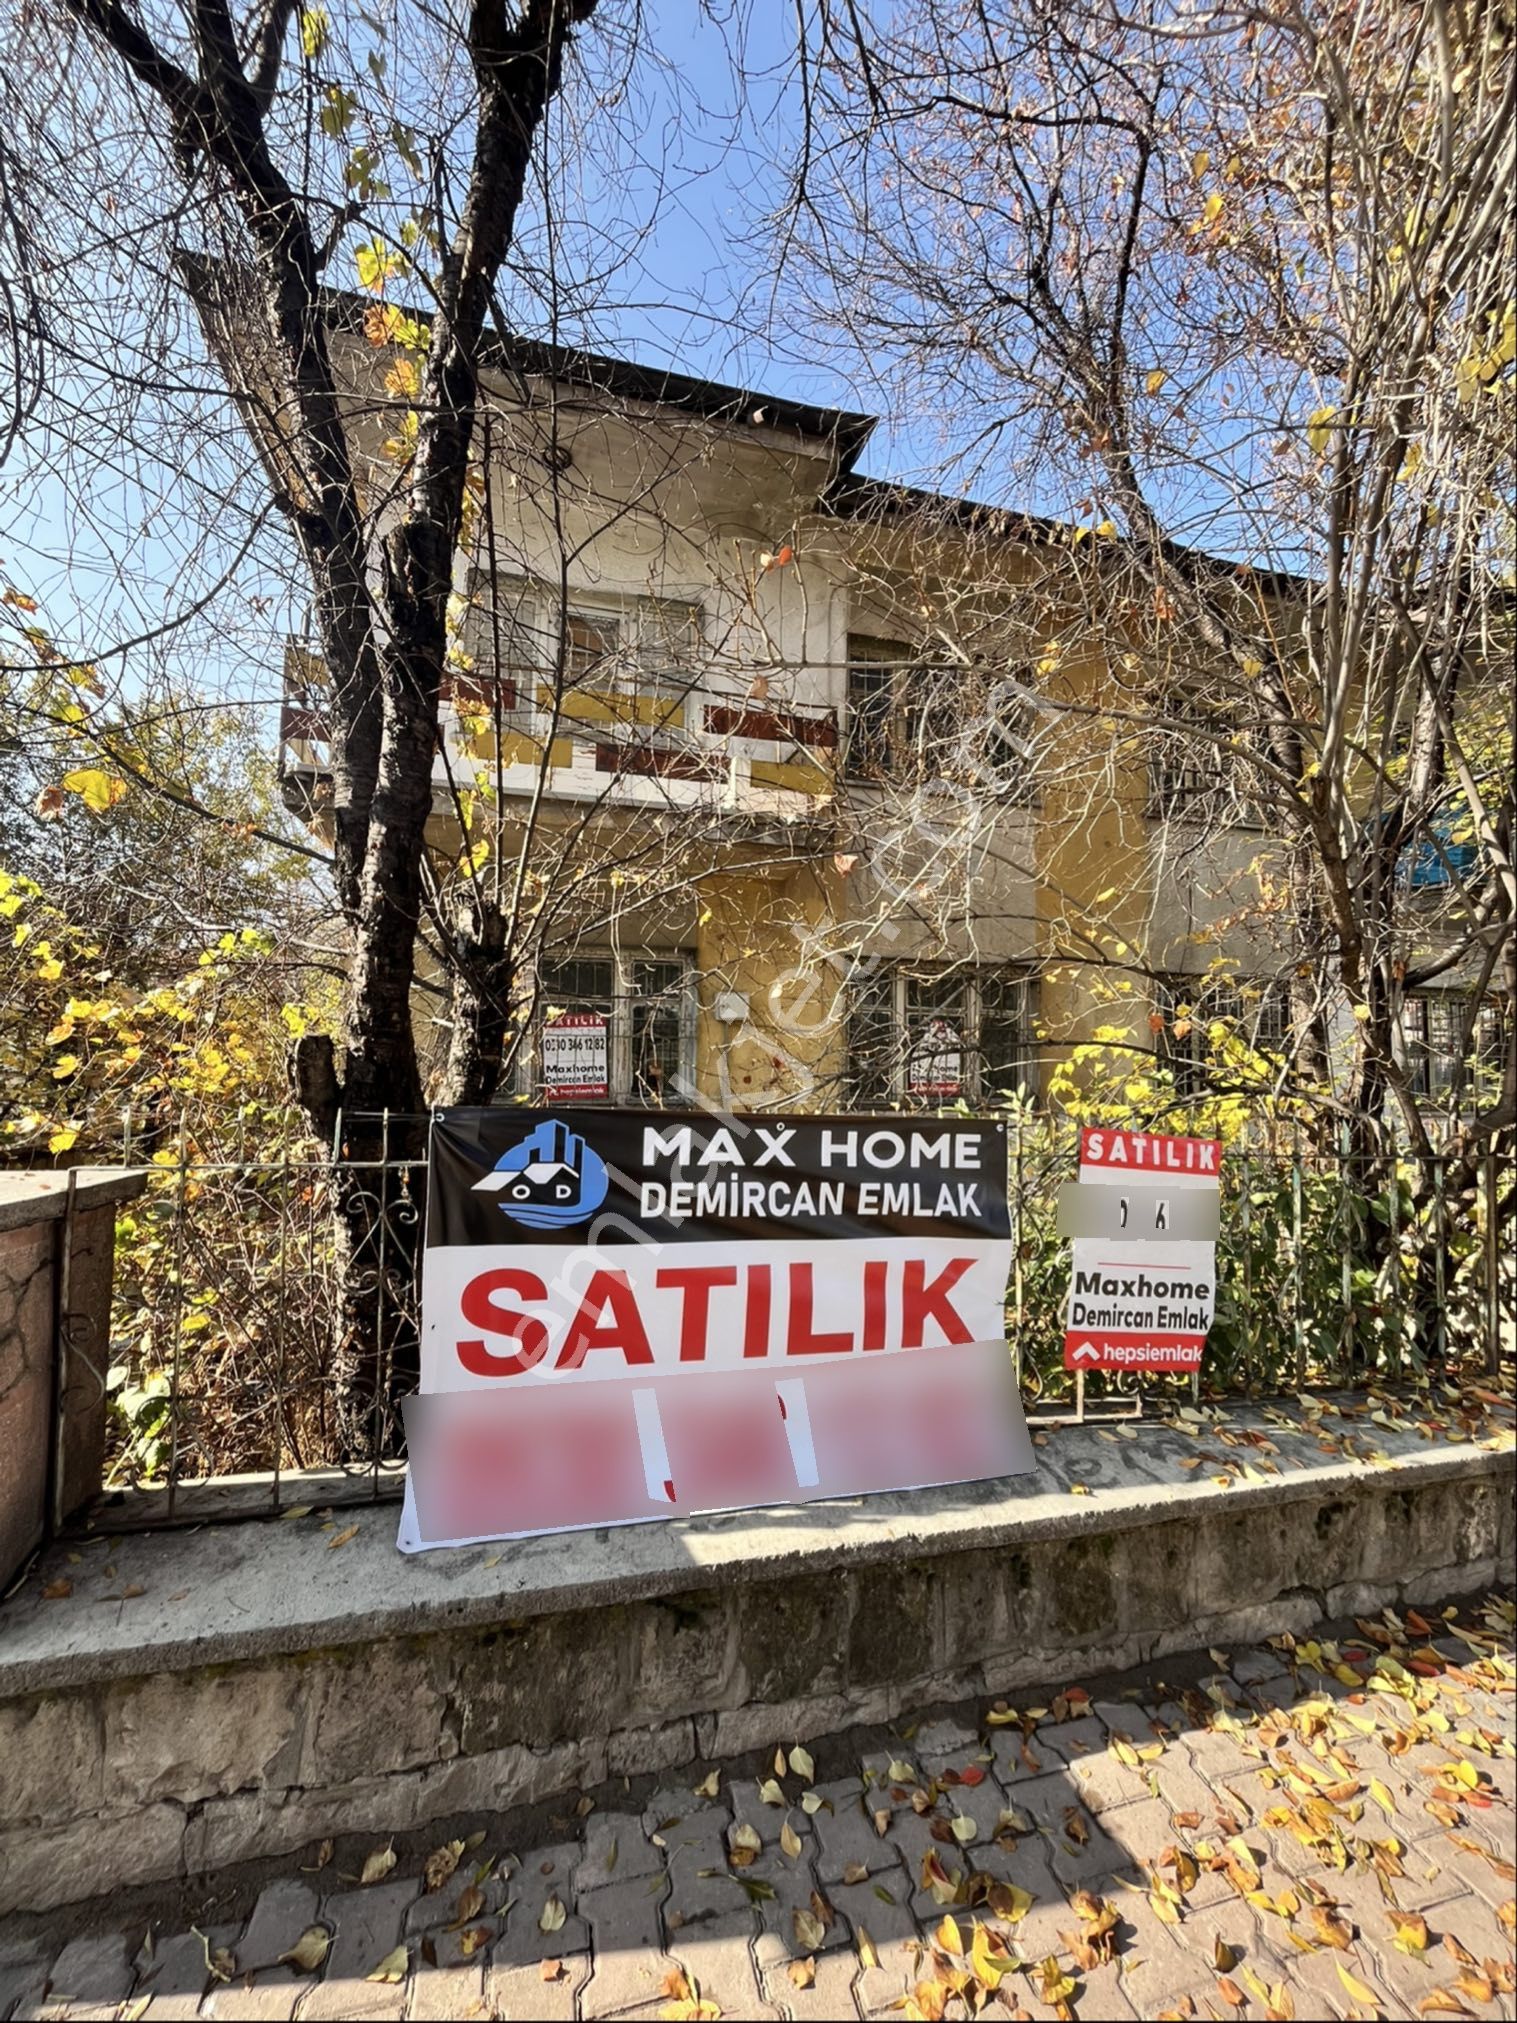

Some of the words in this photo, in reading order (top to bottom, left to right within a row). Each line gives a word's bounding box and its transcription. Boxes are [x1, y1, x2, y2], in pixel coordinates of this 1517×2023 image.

[545, 1064, 605, 1073] Maxhome
[643, 1126, 797, 1169] MAX
[821, 1130, 982, 1169] HOME
[1086, 1132, 1216, 1171] SATILIK
[640, 1172, 845, 1219] DEMİRCAN
[857, 1182, 983, 1218] EMLAK
[1074, 1270, 1211, 1301] Maxhome
[455, 1257, 980, 1378] SATILIK
[1071, 1301, 1154, 1329] Demircan
[1157, 1305, 1210, 1331] Emlak
[1103, 1342, 1203, 1364] hepsiemlak
